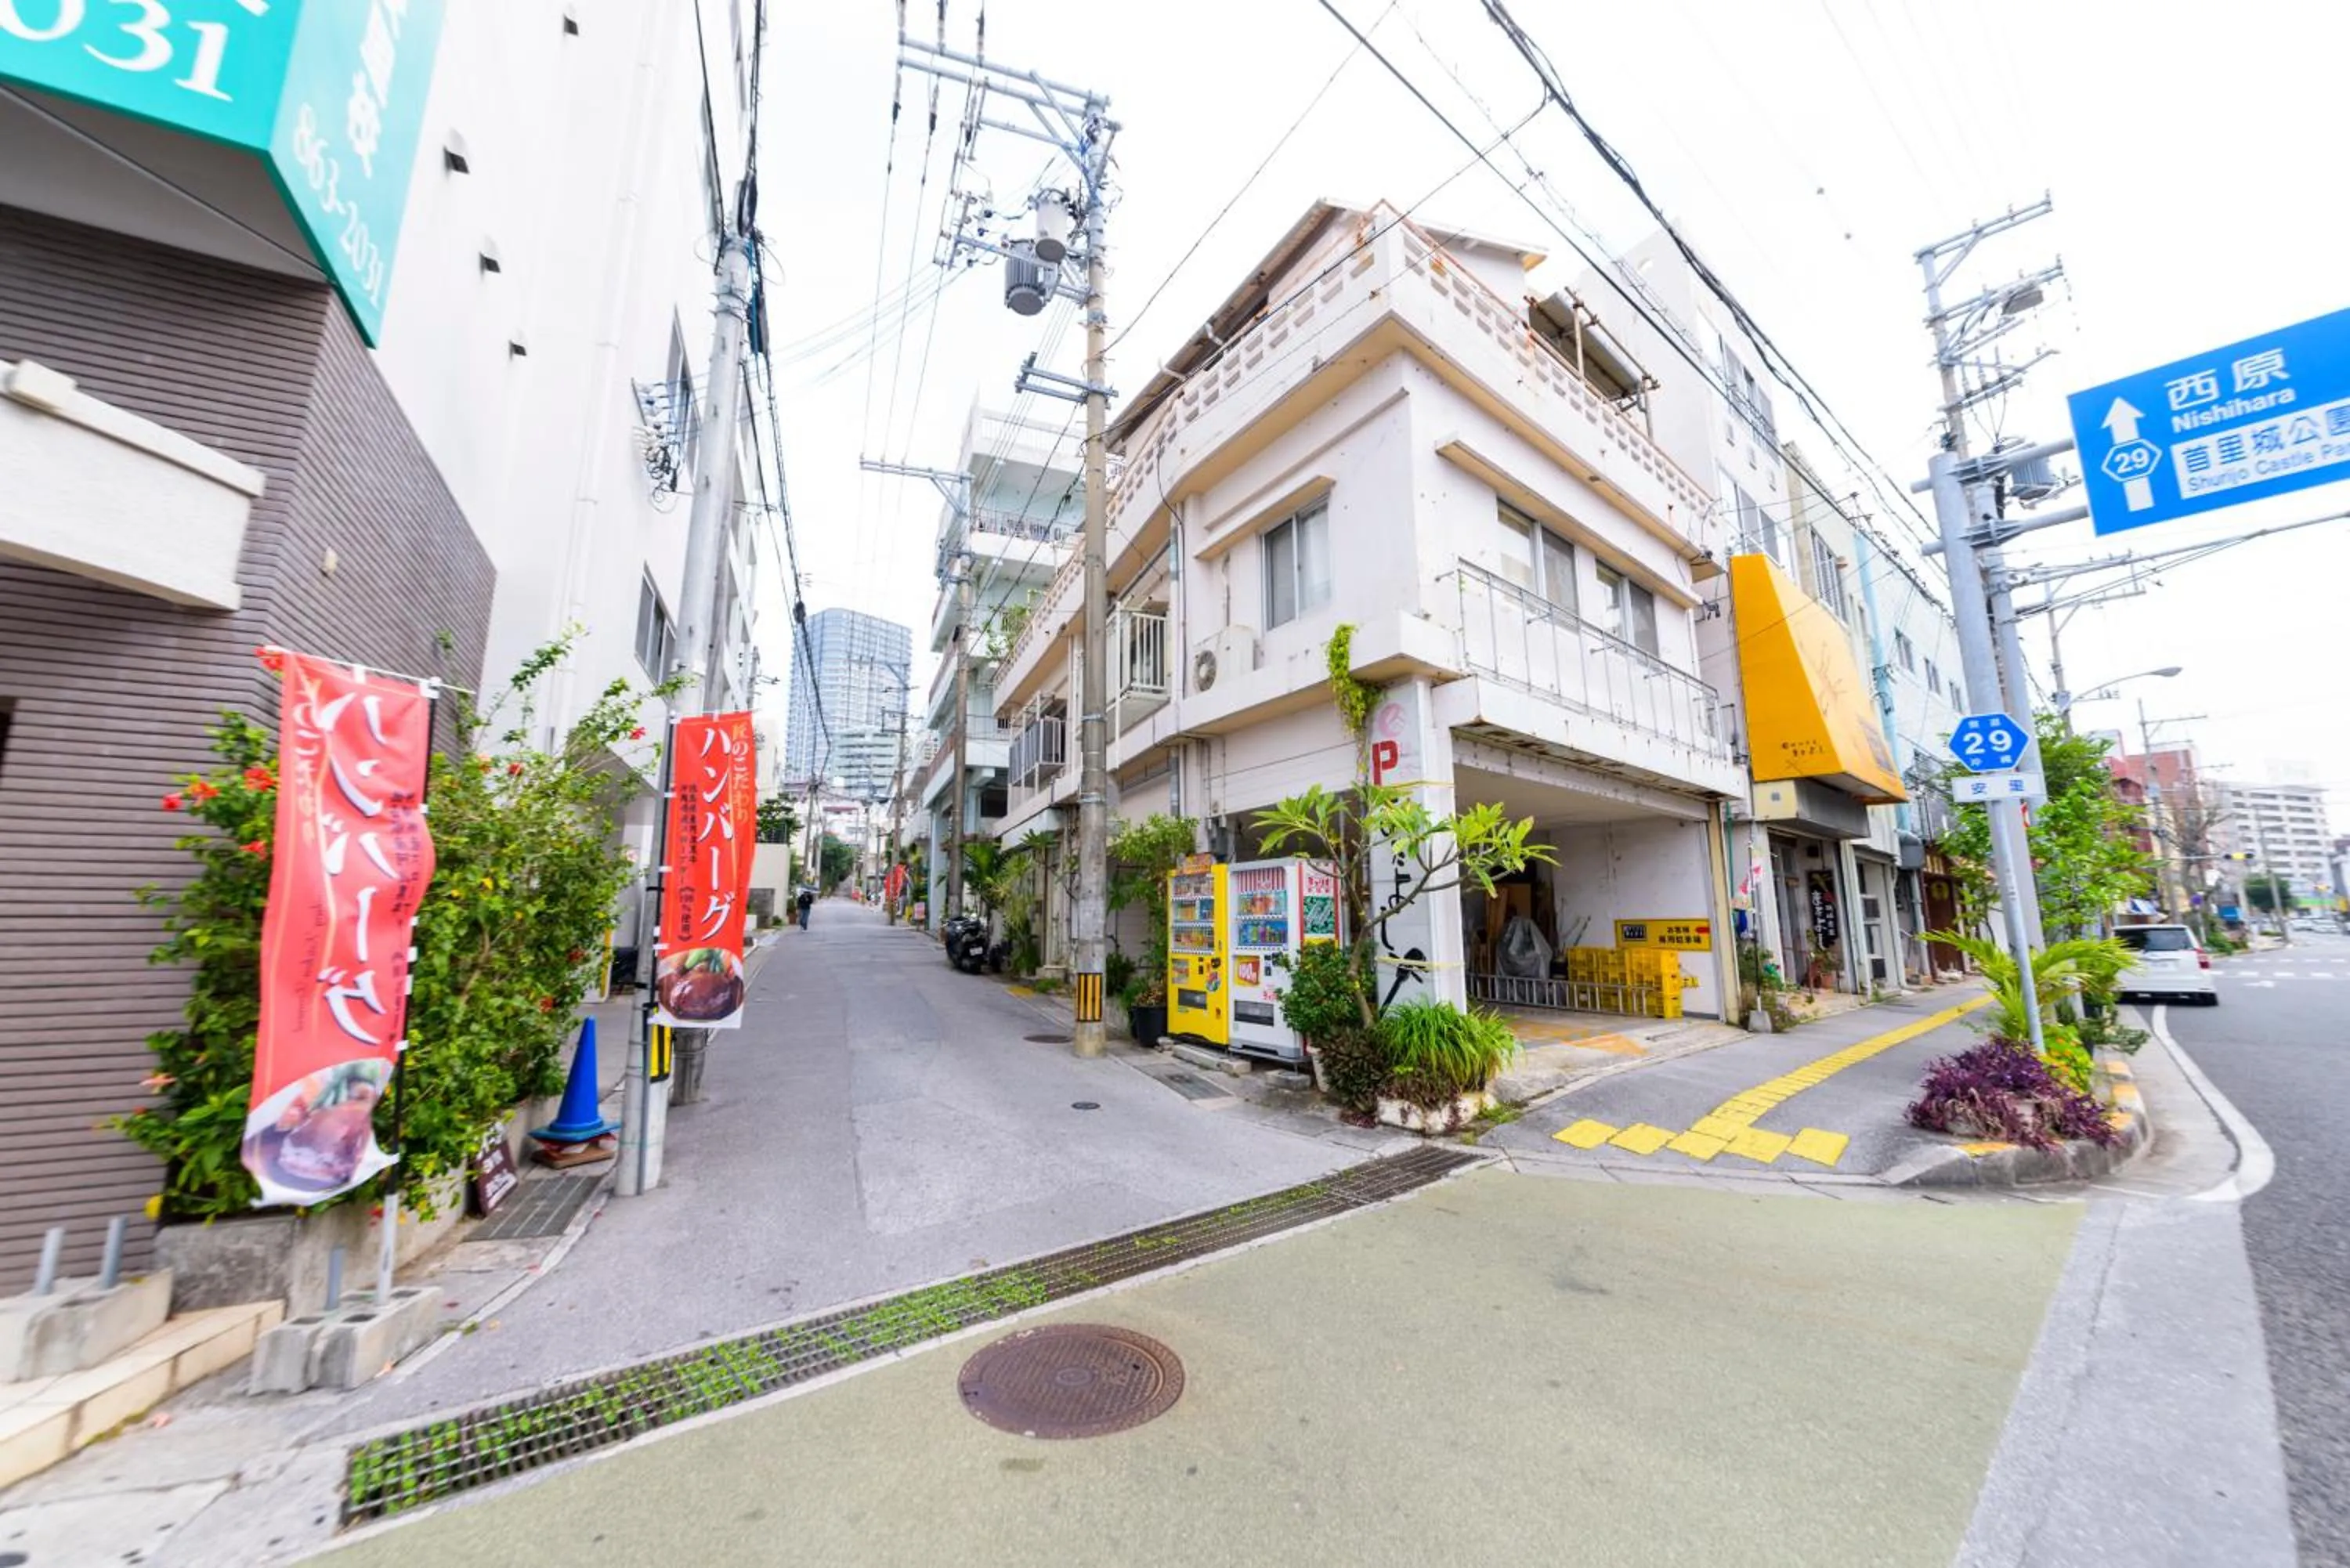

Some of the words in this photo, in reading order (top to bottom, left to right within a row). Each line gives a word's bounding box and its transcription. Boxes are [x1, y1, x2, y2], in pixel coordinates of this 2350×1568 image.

[293, 102, 385, 309] 863-2031
[2164, 348, 2290, 411] 西原
[2171, 388, 2297, 433] Nishihara
[2113, 448, 2149, 473] 29
[2181, 404, 2350, 472] 首里城公園
[2255, 450, 2314, 475] Castle
[2321, 440, 2350, 461] Pa
[1372, 739, 1398, 786] P
[1962, 729, 2012, 756] 29
[1971, 779, 2025, 796] 安里
[697, 727, 736, 941] ハンバーグ
